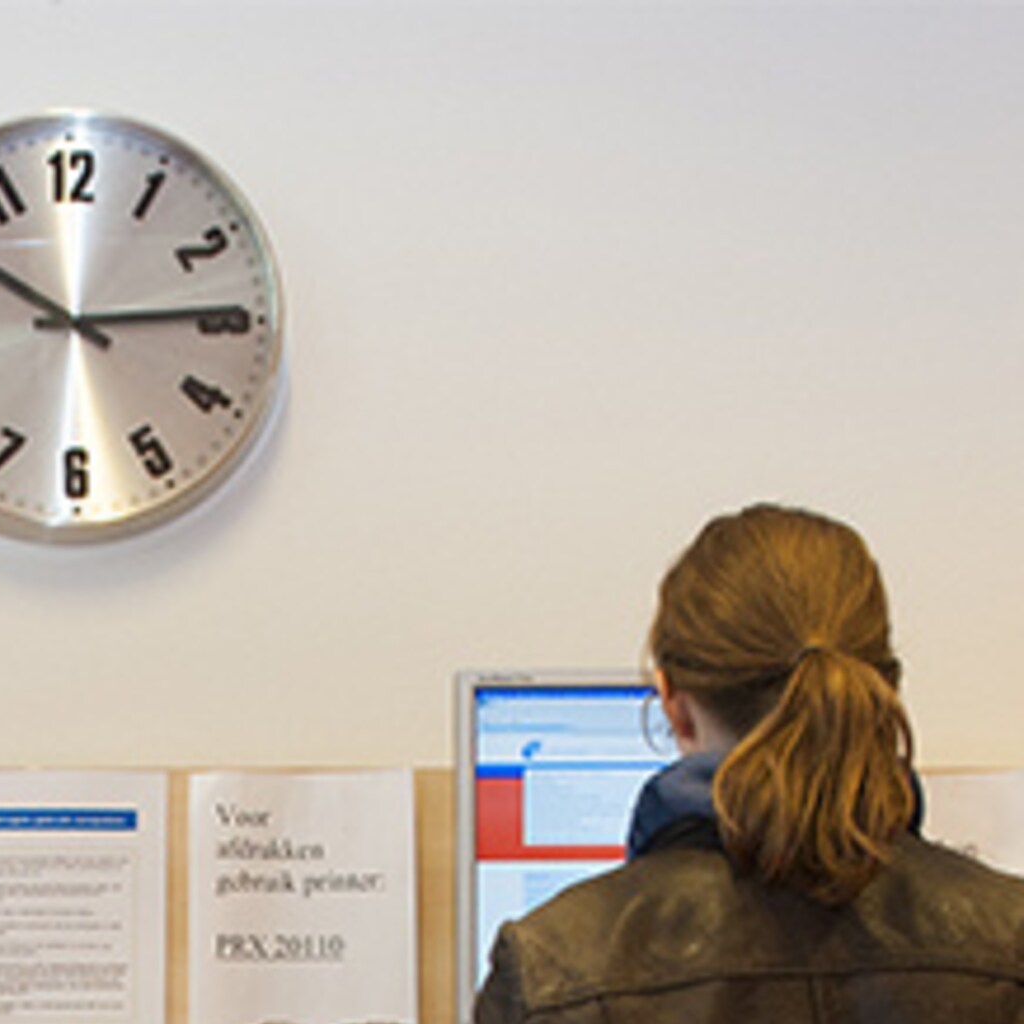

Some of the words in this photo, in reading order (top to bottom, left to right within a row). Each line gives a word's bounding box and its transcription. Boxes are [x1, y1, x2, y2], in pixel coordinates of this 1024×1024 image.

[47, 150, 96, 203] 12
[132, 171, 166, 220] 1
[175, 228, 228, 272] 2
[179, 375, 233, 414] 4
[63, 446, 90, 498] 6
[129, 425, 173, 478] 5
[215, 803, 271, 827] Voor
[215, 837, 325, 860] afdrukken
[215, 870, 295, 898] gebruik
